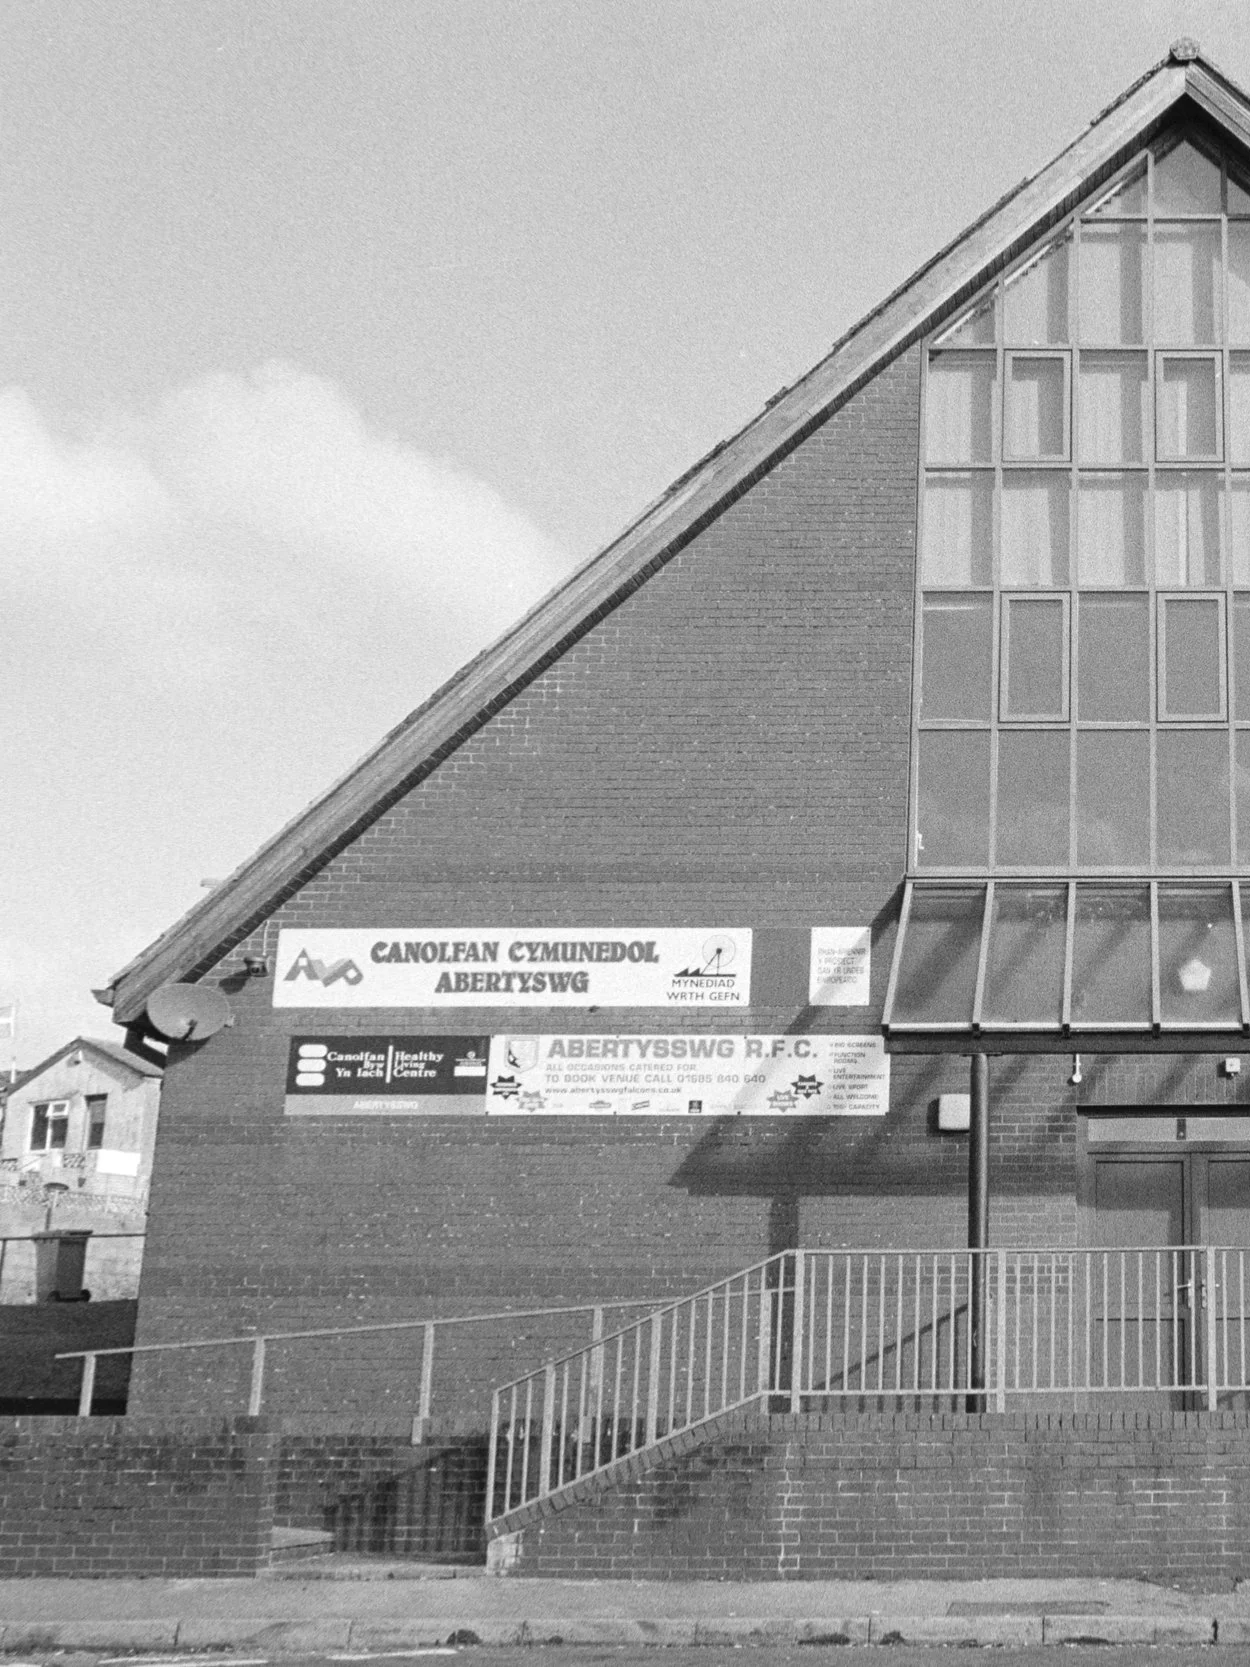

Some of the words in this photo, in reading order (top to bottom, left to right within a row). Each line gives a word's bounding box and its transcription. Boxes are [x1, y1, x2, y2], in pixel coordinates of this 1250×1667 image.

[370, 941, 499, 963] CANOLFAN
[508, 941, 659, 963] CYMUNEDOL
[434, 971, 589, 993] ABERTYSWG
[671, 978, 735, 988] MYNEDIAD
[666, 991, 705, 1001] WRTH
[709, 991, 740, 1001] GEFN
[547, 1038, 735, 1059] ABERTYSSWG
[744, 1038, 818, 1059] R.F.C.
[327, 1051, 385, 1062] Canolfan
[394, 1051, 444, 1062] Healthy
[363, 1061, 385, 1069] Byw
[393, 1061, 426, 1071] Living
[546, 1063, 563, 1072] ALL
[566, 1063, 626, 1072] OCCASIONS
[628, 1063, 674, 1072] CATERED
[676, 1063, 697, 1072] FOR
[335, 1067, 351, 1077] Yn
[356, 1067, 384, 1077] Iach
[393, 1067, 437, 1078] Centre
[545, 1074, 559, 1083] TO
[564, 1074, 597, 1083] BOOK
[601, 1074, 640, 1083] VENUE
[644, 1074, 672, 1083] CALL
[716, 1074, 739, 1083] 840
[743, 1074, 766, 1083] 640
